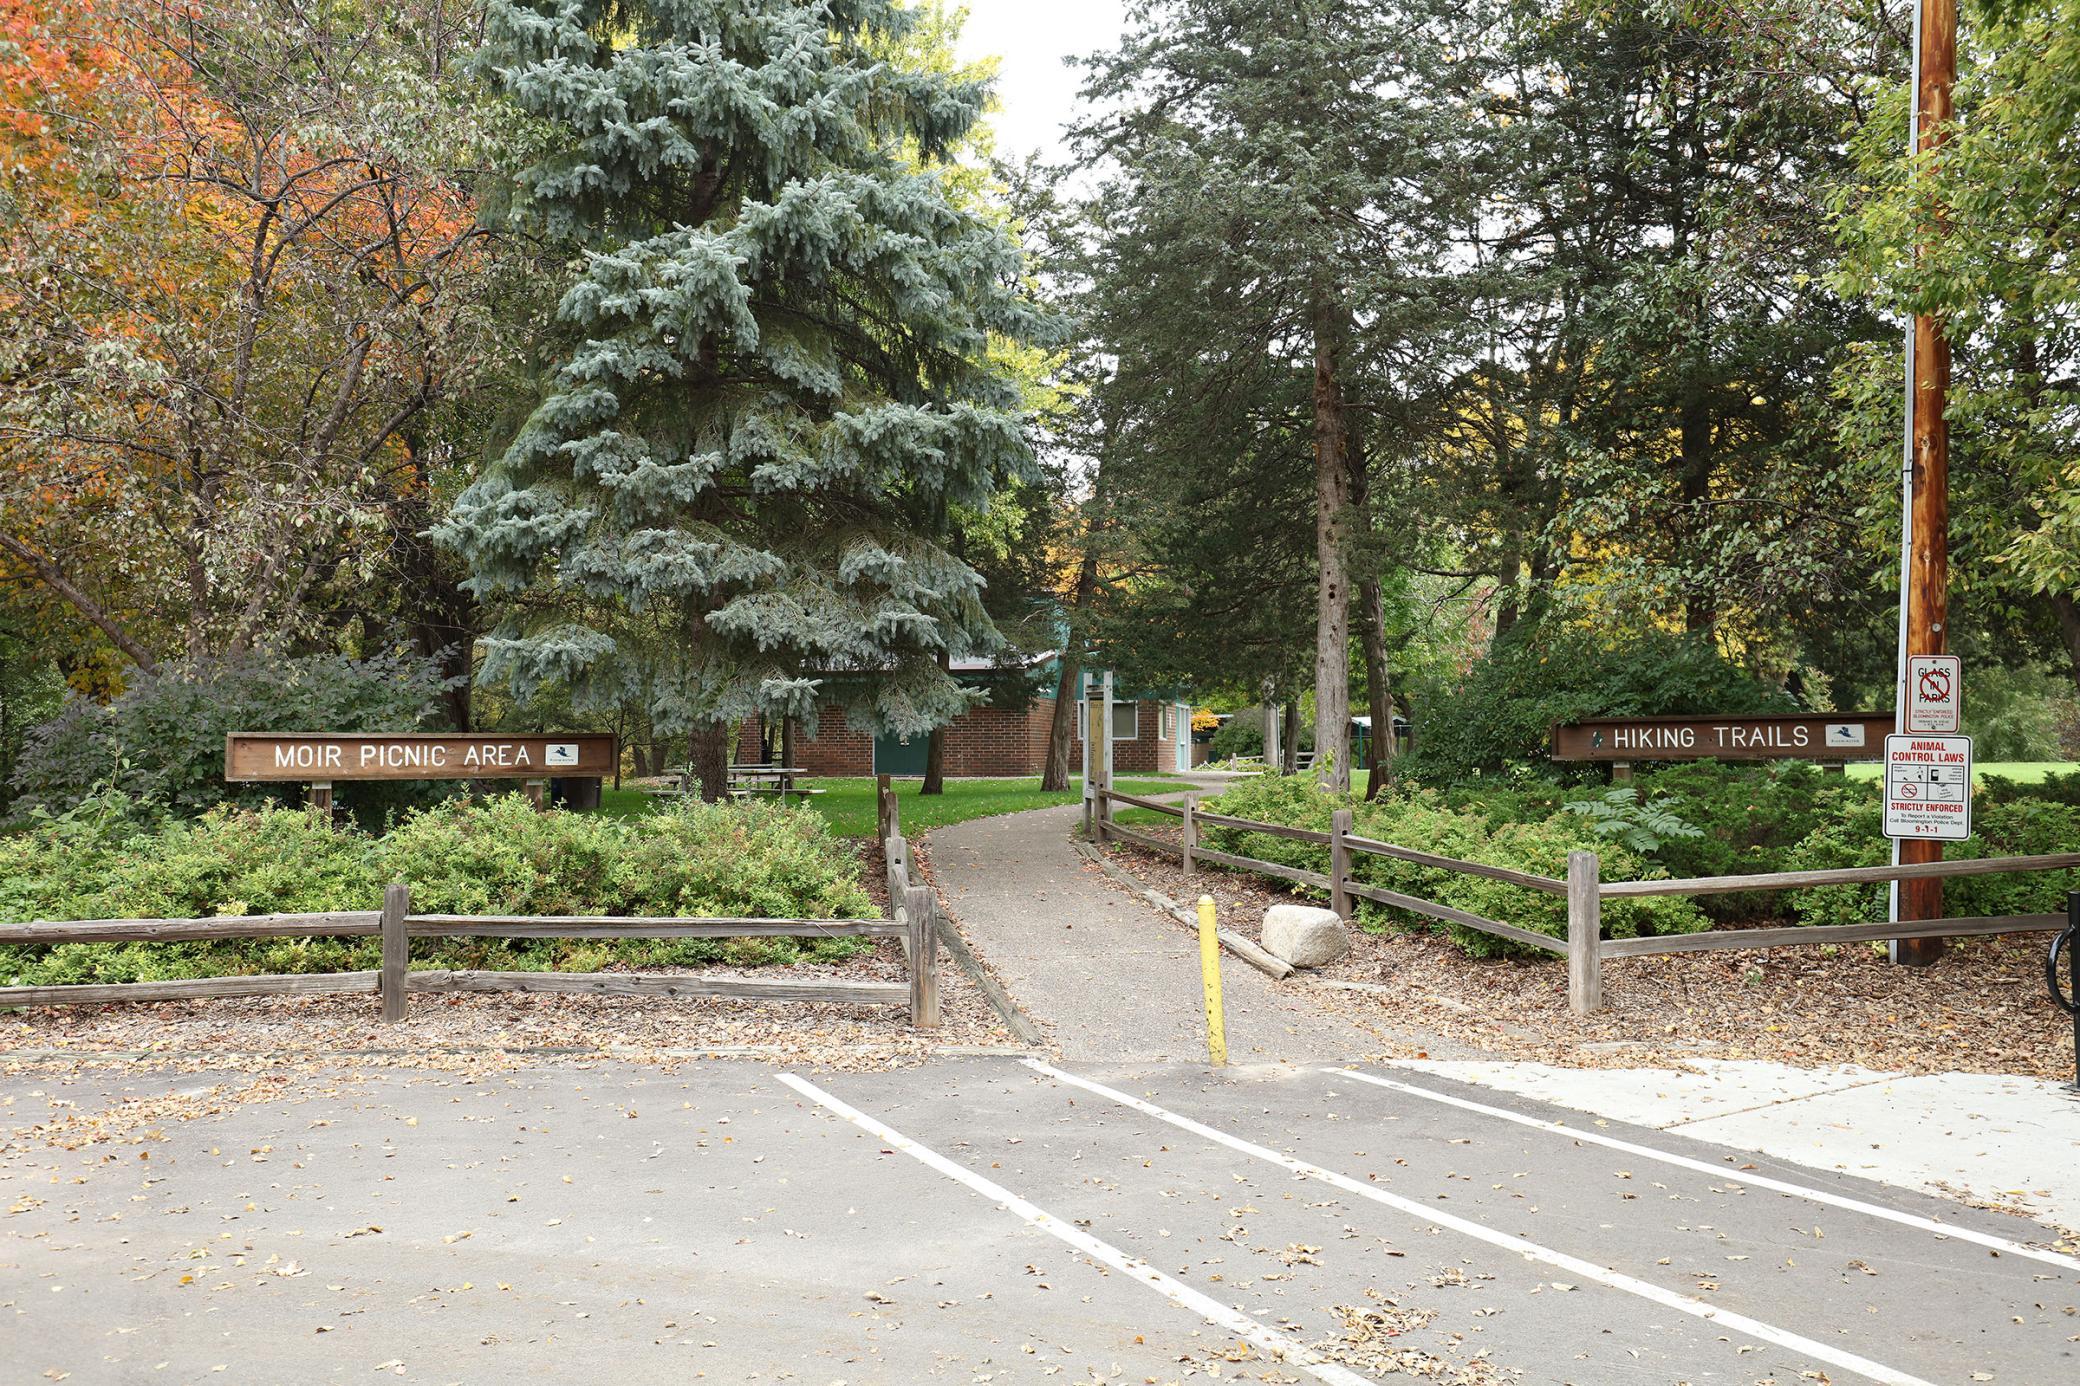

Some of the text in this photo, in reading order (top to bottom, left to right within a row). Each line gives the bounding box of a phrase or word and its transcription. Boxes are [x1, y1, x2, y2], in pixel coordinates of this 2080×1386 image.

[1918, 667, 1951, 677] GLASS
[1919, 693, 1951, 703] PARKS
[1614, 725, 1809, 749] HIKING TRAILS
[1910, 741, 1946, 751] ANIMAL
[275, 744, 531, 768] MOIR PICNIC AREA
[1892, 752, 1965, 763] CONTROL LAWS
[1891, 802, 1963, 813] STRICTLY ENFORCED
[1915, 825, 1938, 833] 9-1-1
